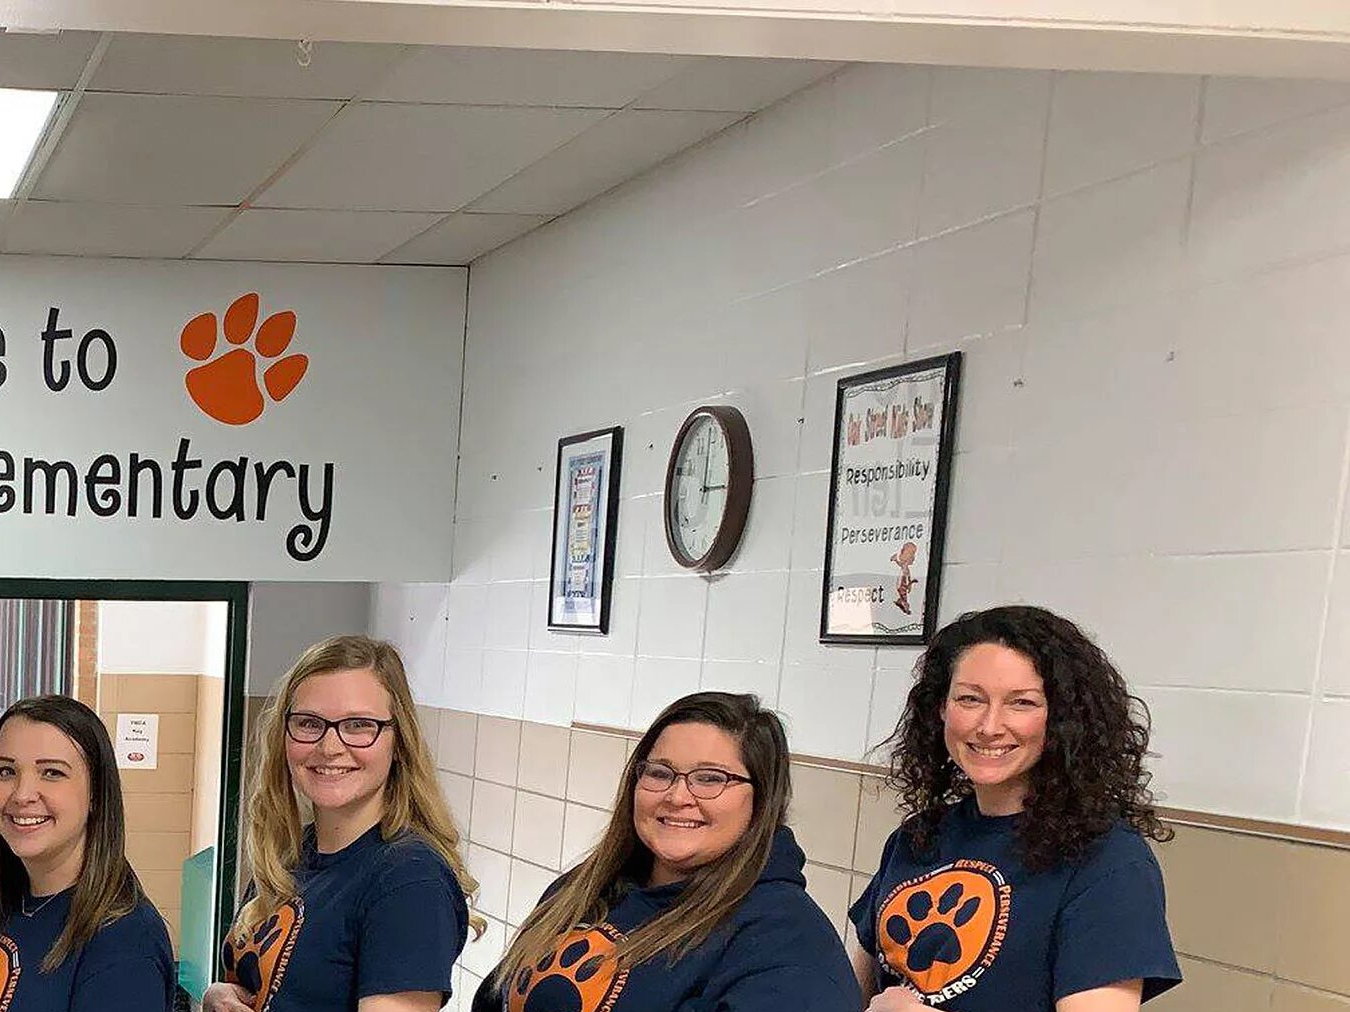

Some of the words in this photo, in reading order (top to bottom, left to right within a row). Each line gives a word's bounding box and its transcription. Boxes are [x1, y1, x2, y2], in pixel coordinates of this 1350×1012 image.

[40, 306, 116, 393] to
[847, 458, 930, 488] Responsibility
[841, 523, 924, 545] Perseverance
[837, 585, 885, 605] Respect
[981, 885, 1012, 968] PERSEVERANCE
